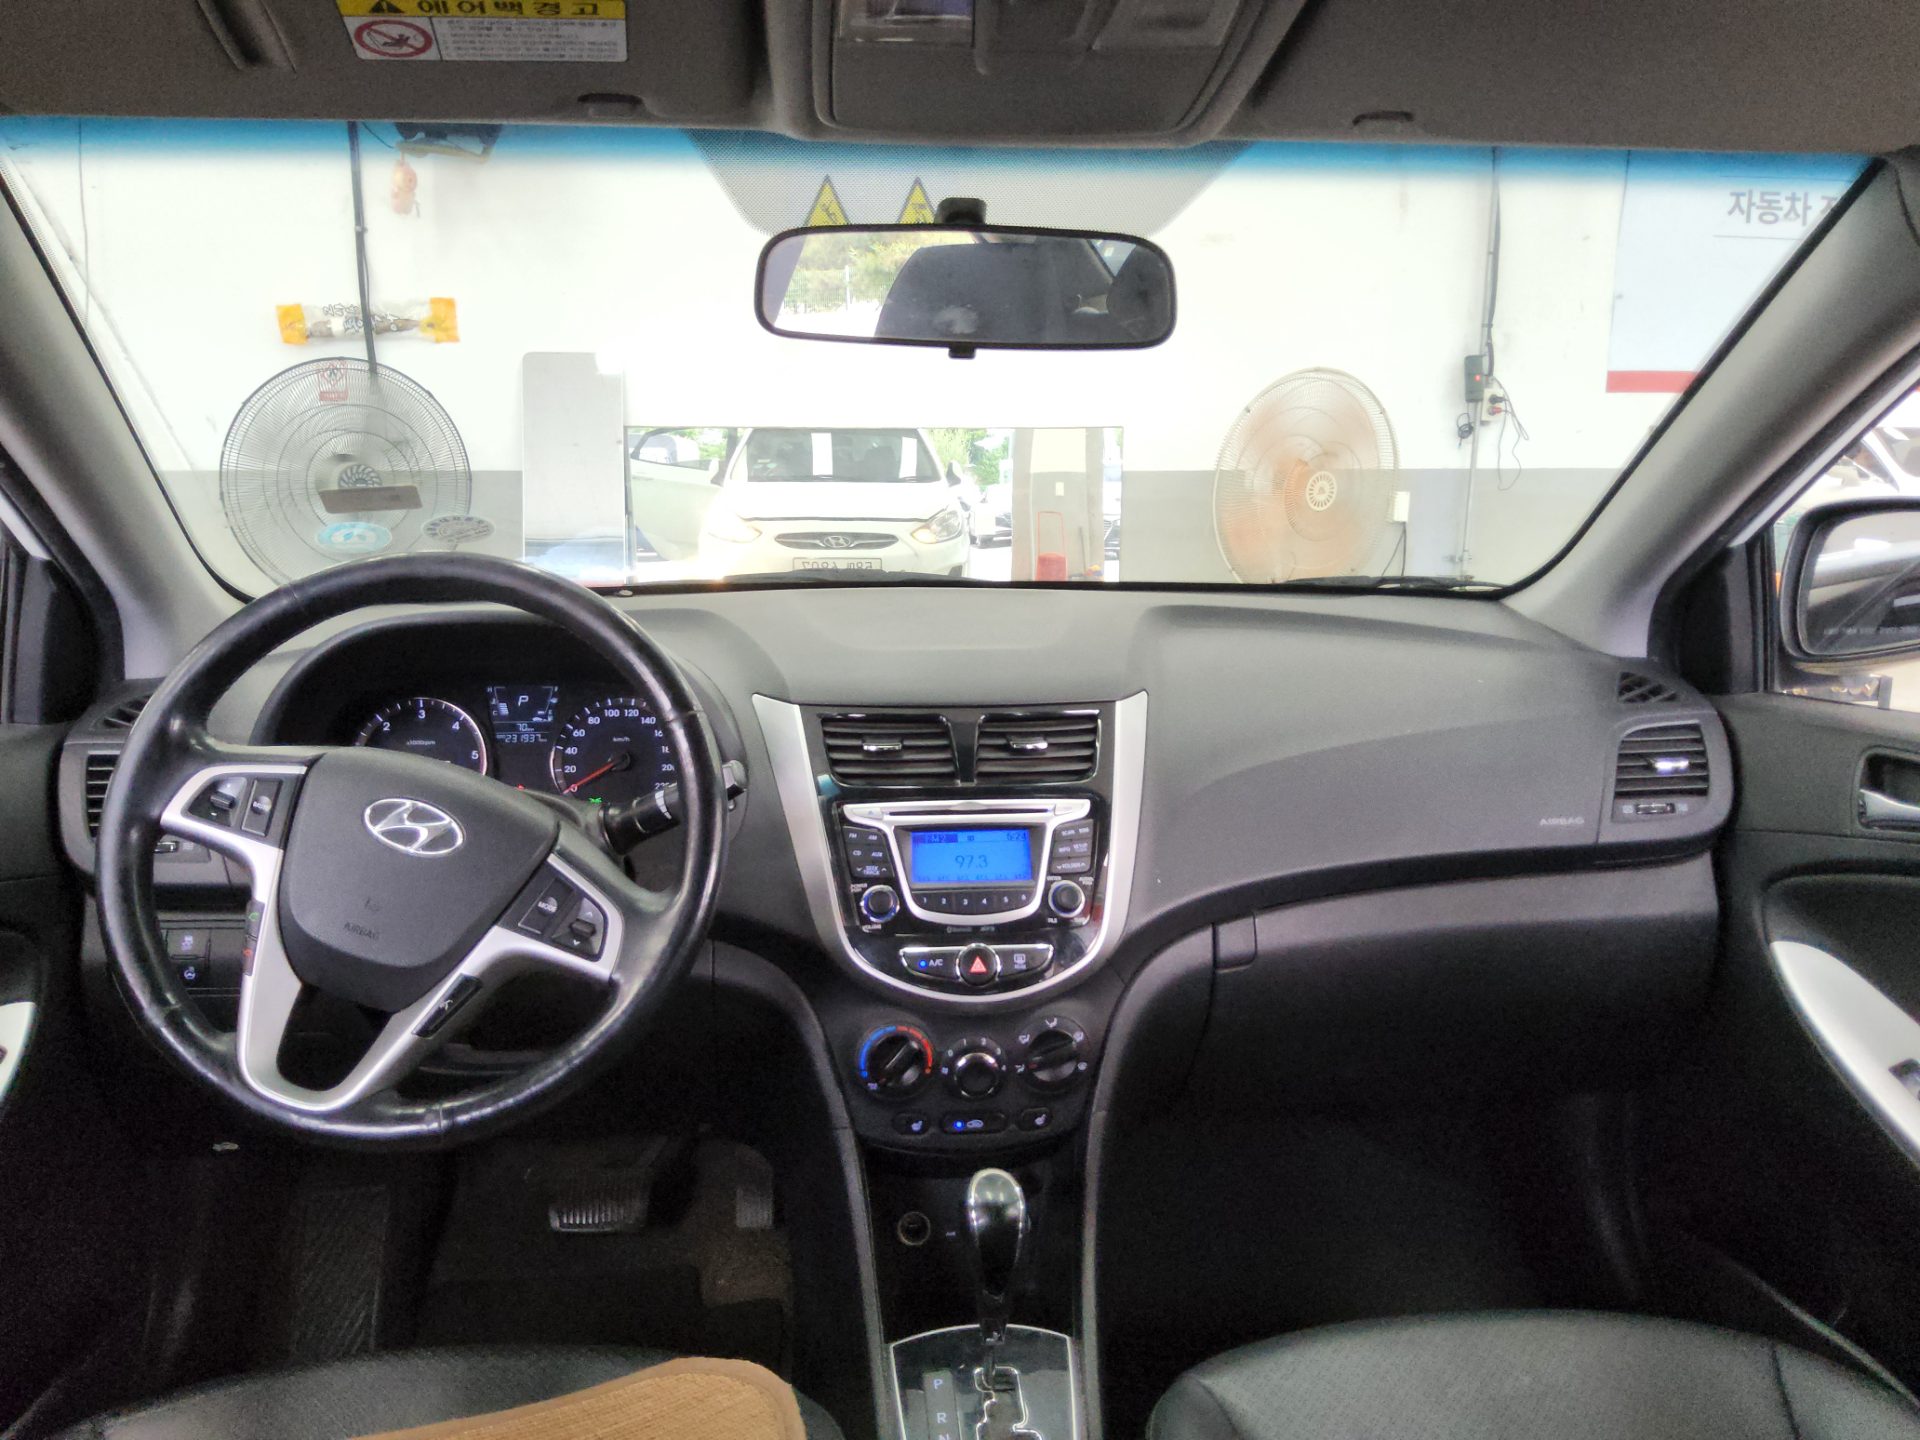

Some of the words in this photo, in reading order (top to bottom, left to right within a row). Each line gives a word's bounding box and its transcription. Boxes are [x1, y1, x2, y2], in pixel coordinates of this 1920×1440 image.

[1727, 189, 1812, 226] 자동차
[518, 695, 529, 707] P
[418, 709, 426, 719] 3
[604, 709, 620, 717] 100
[624, 709, 639, 717] 120
[588, 716, 600, 724] 80
[641, 716, 656, 724] 140
[382, 721, 391, 731] 2
[452, 721, 460, 730] 4
[572, 729, 585, 737] 60
[471, 750, 479, 760] 5
[565, 747, 578, 755] 40
[564, 765, 576, 773] 20
[570, 784, 578, 792] 0
[1539, 816, 1585, 826] AIRBAG
[941, 897, 947, 905] 2
[962, 898, 969, 906] 3
[981, 897, 988, 905] 4
[928, 959, 944, 967] A/C
[981, 1038, 987, 1046] 2
[933, 1379, 943, 1389] P
[936, 1413, 946, 1423] R
